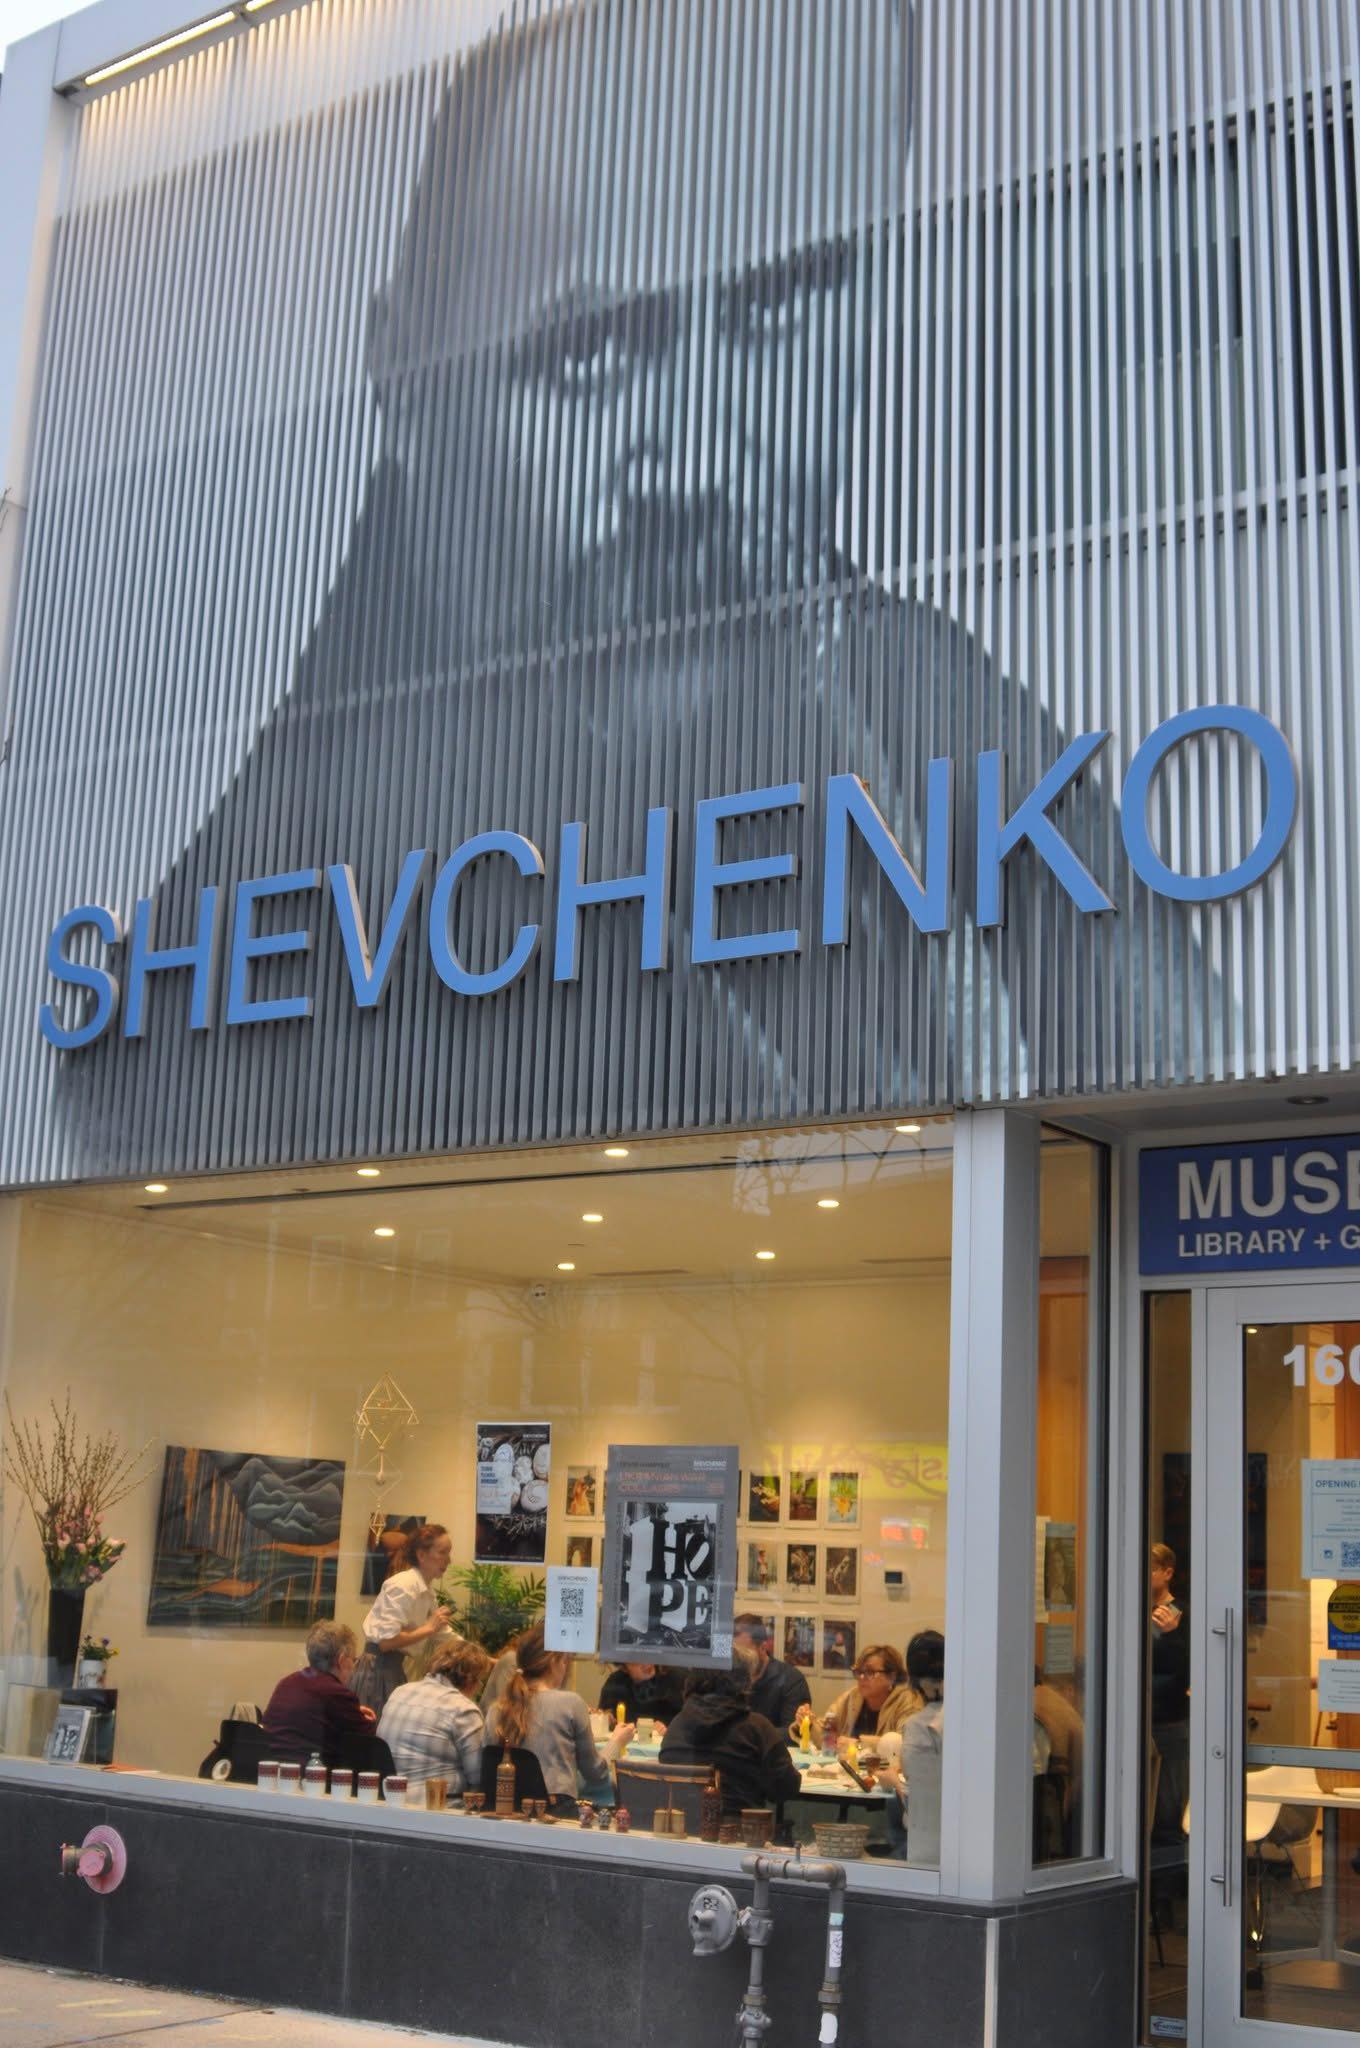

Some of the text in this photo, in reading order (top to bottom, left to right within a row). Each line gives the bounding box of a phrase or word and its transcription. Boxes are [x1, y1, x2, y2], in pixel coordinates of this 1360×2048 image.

[39, 703, 1299, 1050] SHEVCHENKO
[1177, 1229, 1306, 1258] LIBRARY
[1315, 1479, 1357, 1489] OPENING
